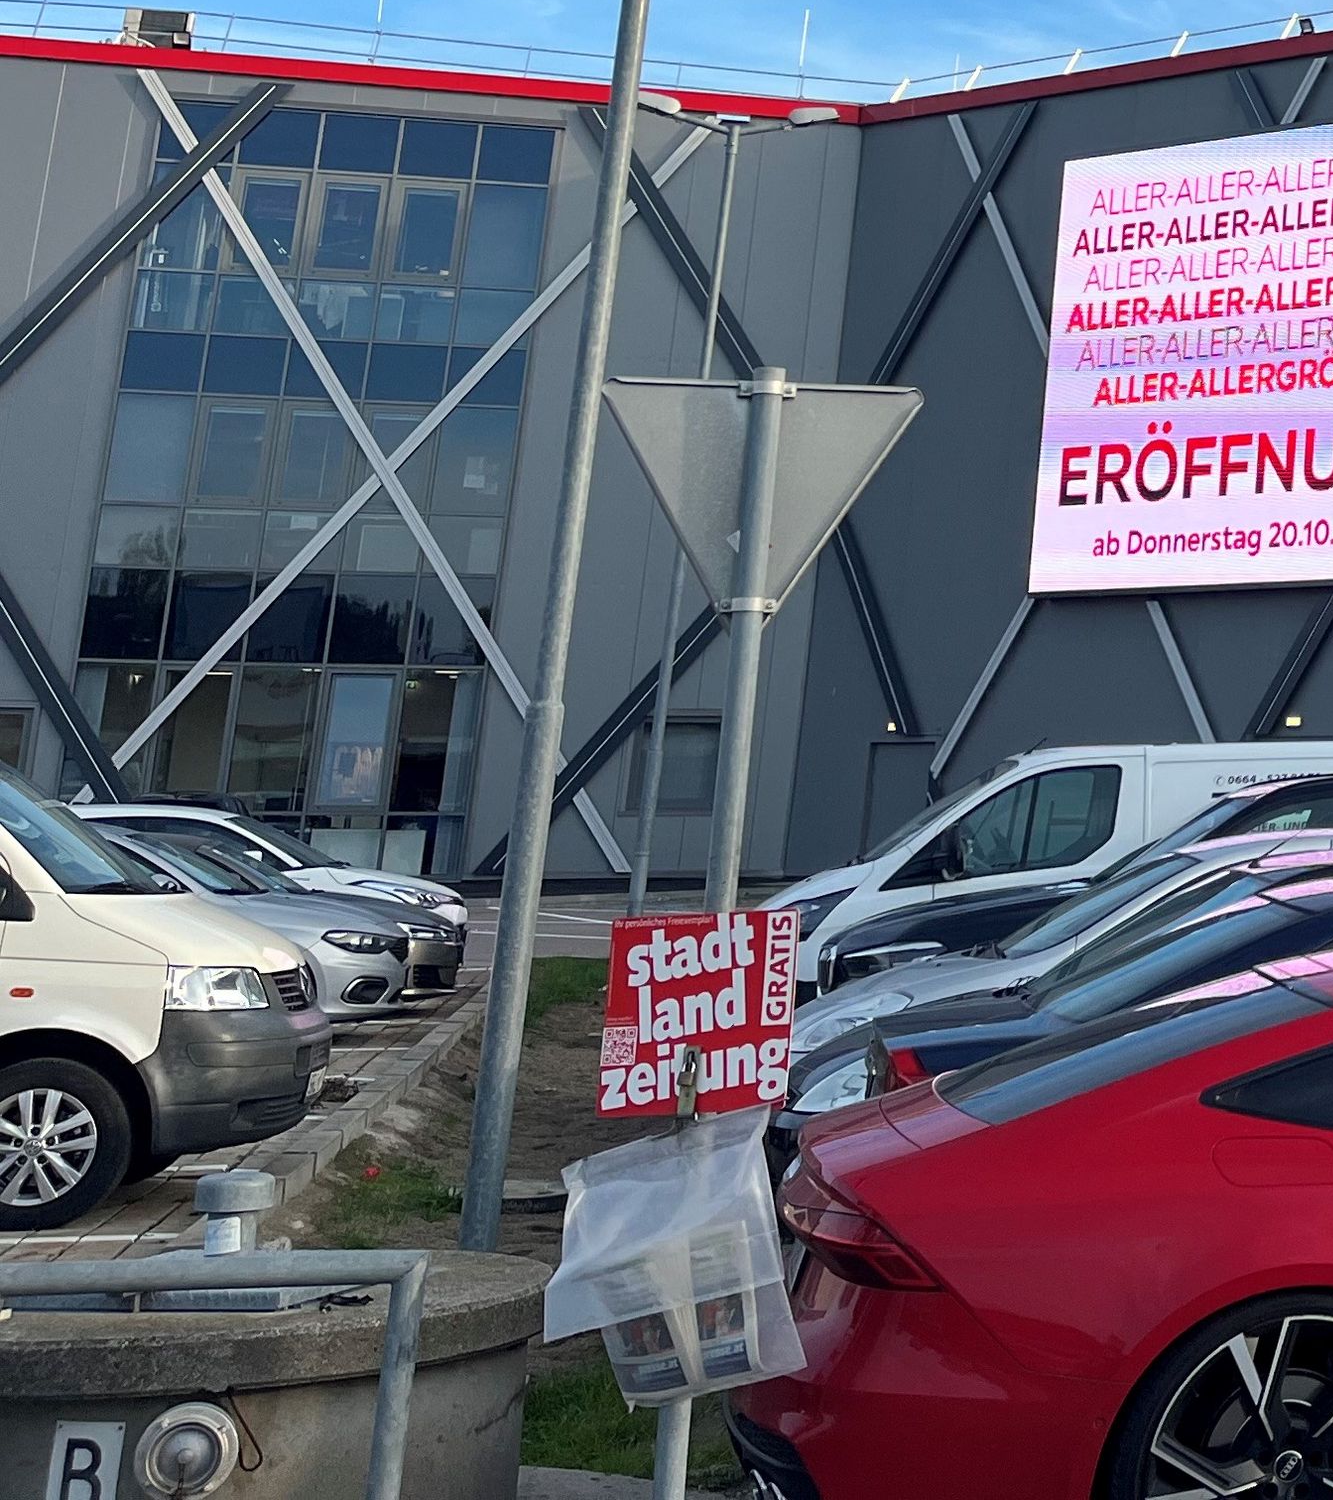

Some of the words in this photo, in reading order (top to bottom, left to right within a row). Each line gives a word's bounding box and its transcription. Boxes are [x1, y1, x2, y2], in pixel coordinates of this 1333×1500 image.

[1092, 530, 1120, 556] ab
[1127, 523, 1262, 555] Donnerstag
[627, 913, 755, 987] stadt
[766, 915, 792, 1021] GRATIS
[638, 967, 747, 1044] land
